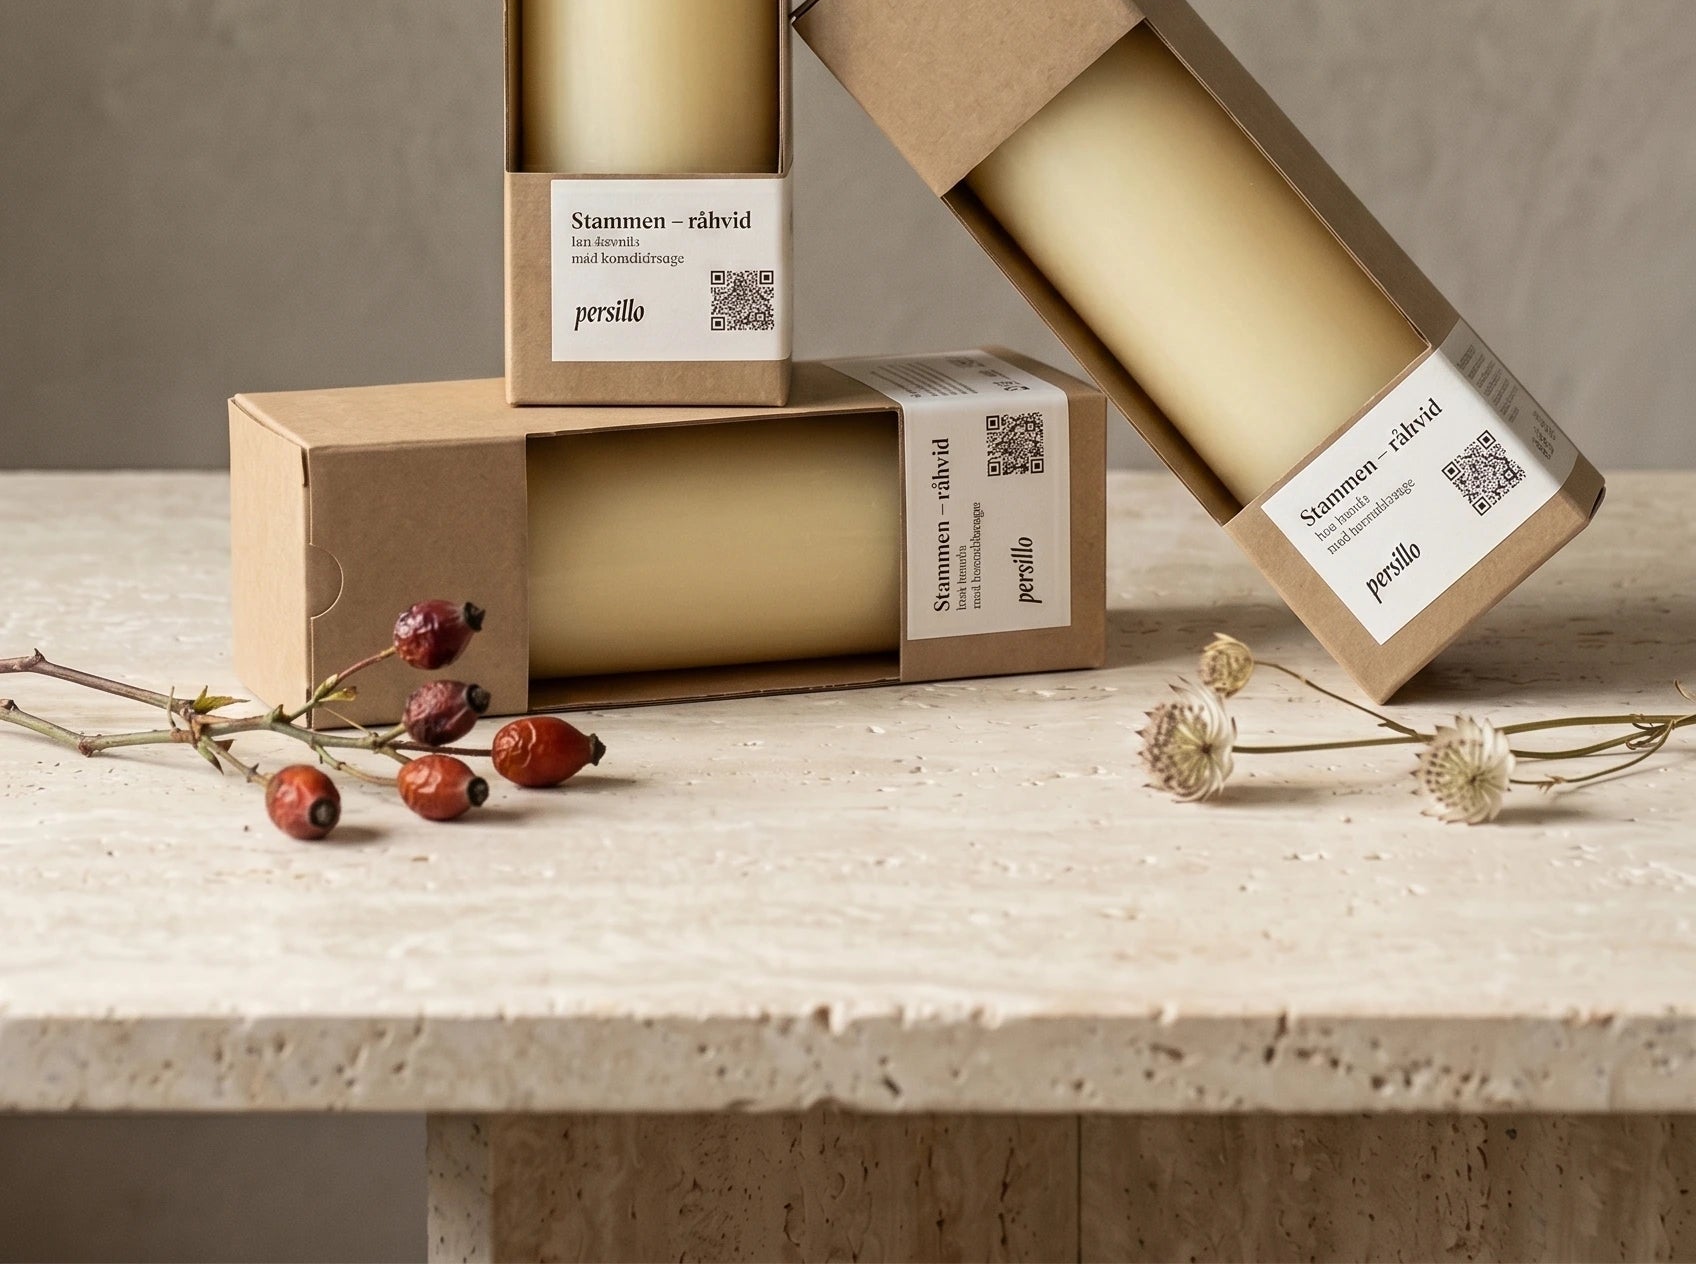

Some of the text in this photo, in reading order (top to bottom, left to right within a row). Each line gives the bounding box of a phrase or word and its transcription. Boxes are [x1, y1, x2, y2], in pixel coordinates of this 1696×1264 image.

[571, 211, 666, 230] Stammen
[688, 210, 752, 229] råhvid
[574, 298, 646, 331] persillo
[931, 438, 951, 500] råhvid
[1300, 459, 1379, 527] Stammen
[1388, 397, 1443, 453] råhvid
[933, 520, 951, 612] Stammen
[1010, 536, 1043, 604] persillo
[1365, 542, 1421, 605] persillo
